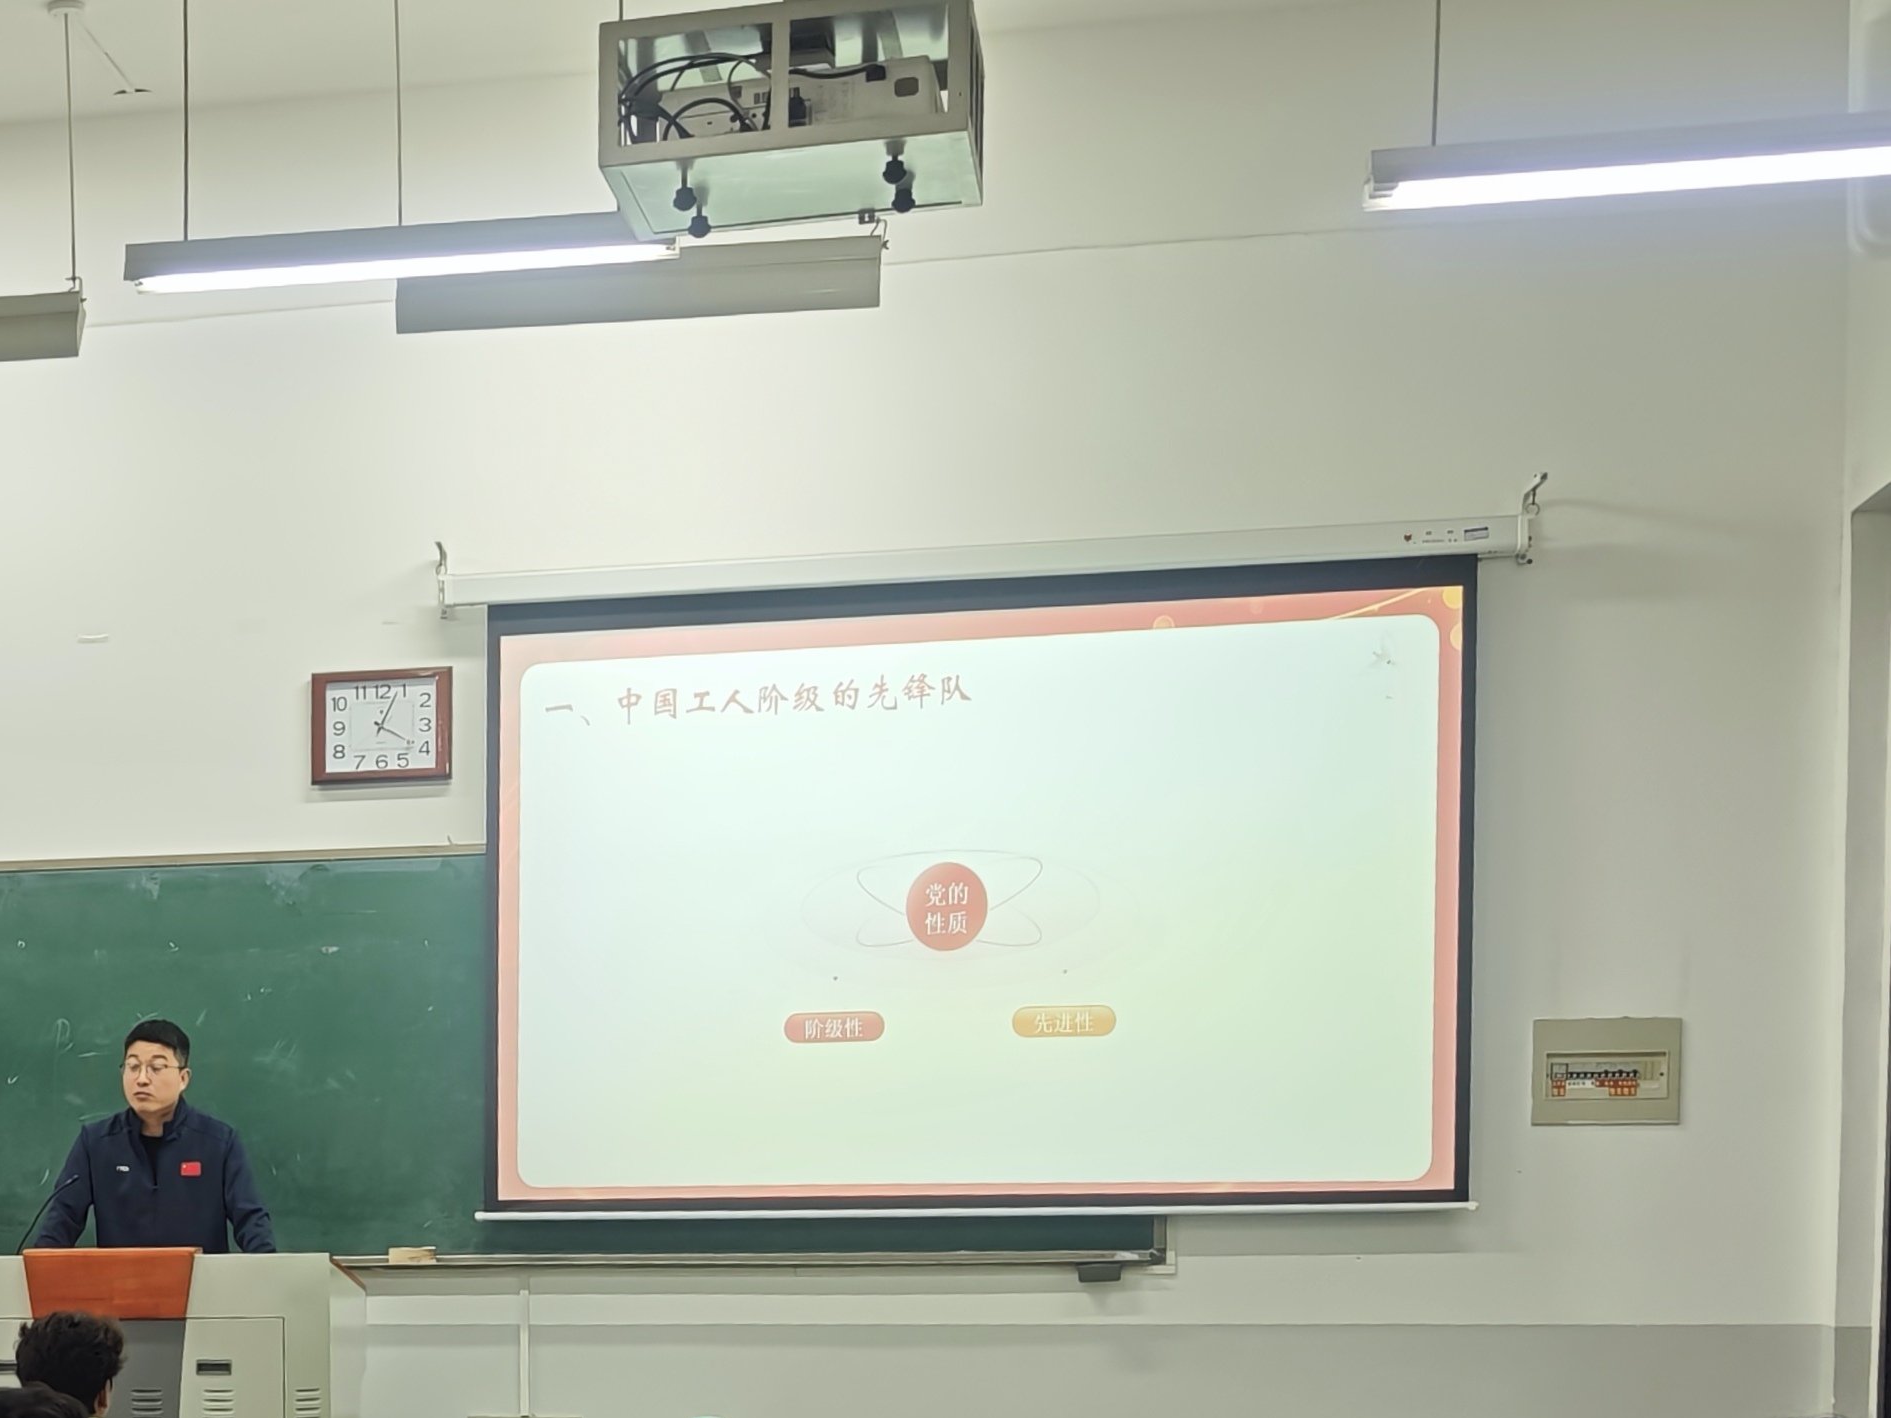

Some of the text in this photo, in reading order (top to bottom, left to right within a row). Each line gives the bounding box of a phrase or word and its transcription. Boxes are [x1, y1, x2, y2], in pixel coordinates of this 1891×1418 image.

[354, 685, 367, 700] 11
[373, 684, 391, 699] 12
[402, 684, 407, 698] 1
[331, 696, 348, 712] 10
[419, 692, 432, 708] 2
[333, 721, 346, 736] 9
[418, 717, 432, 732] 3
[332, 744, 346, 759] 8
[418, 740, 431, 756] 4
[353, 755, 366, 770] 7
[375, 754, 388, 769] 6
[397, 752, 410, 768] 5
[925, 881, 969, 907] 党的
[924, 911, 968, 936] 性质
[804, 1017, 864, 1039] 阶级性
[1034, 1011, 1094, 1034] 先进性
